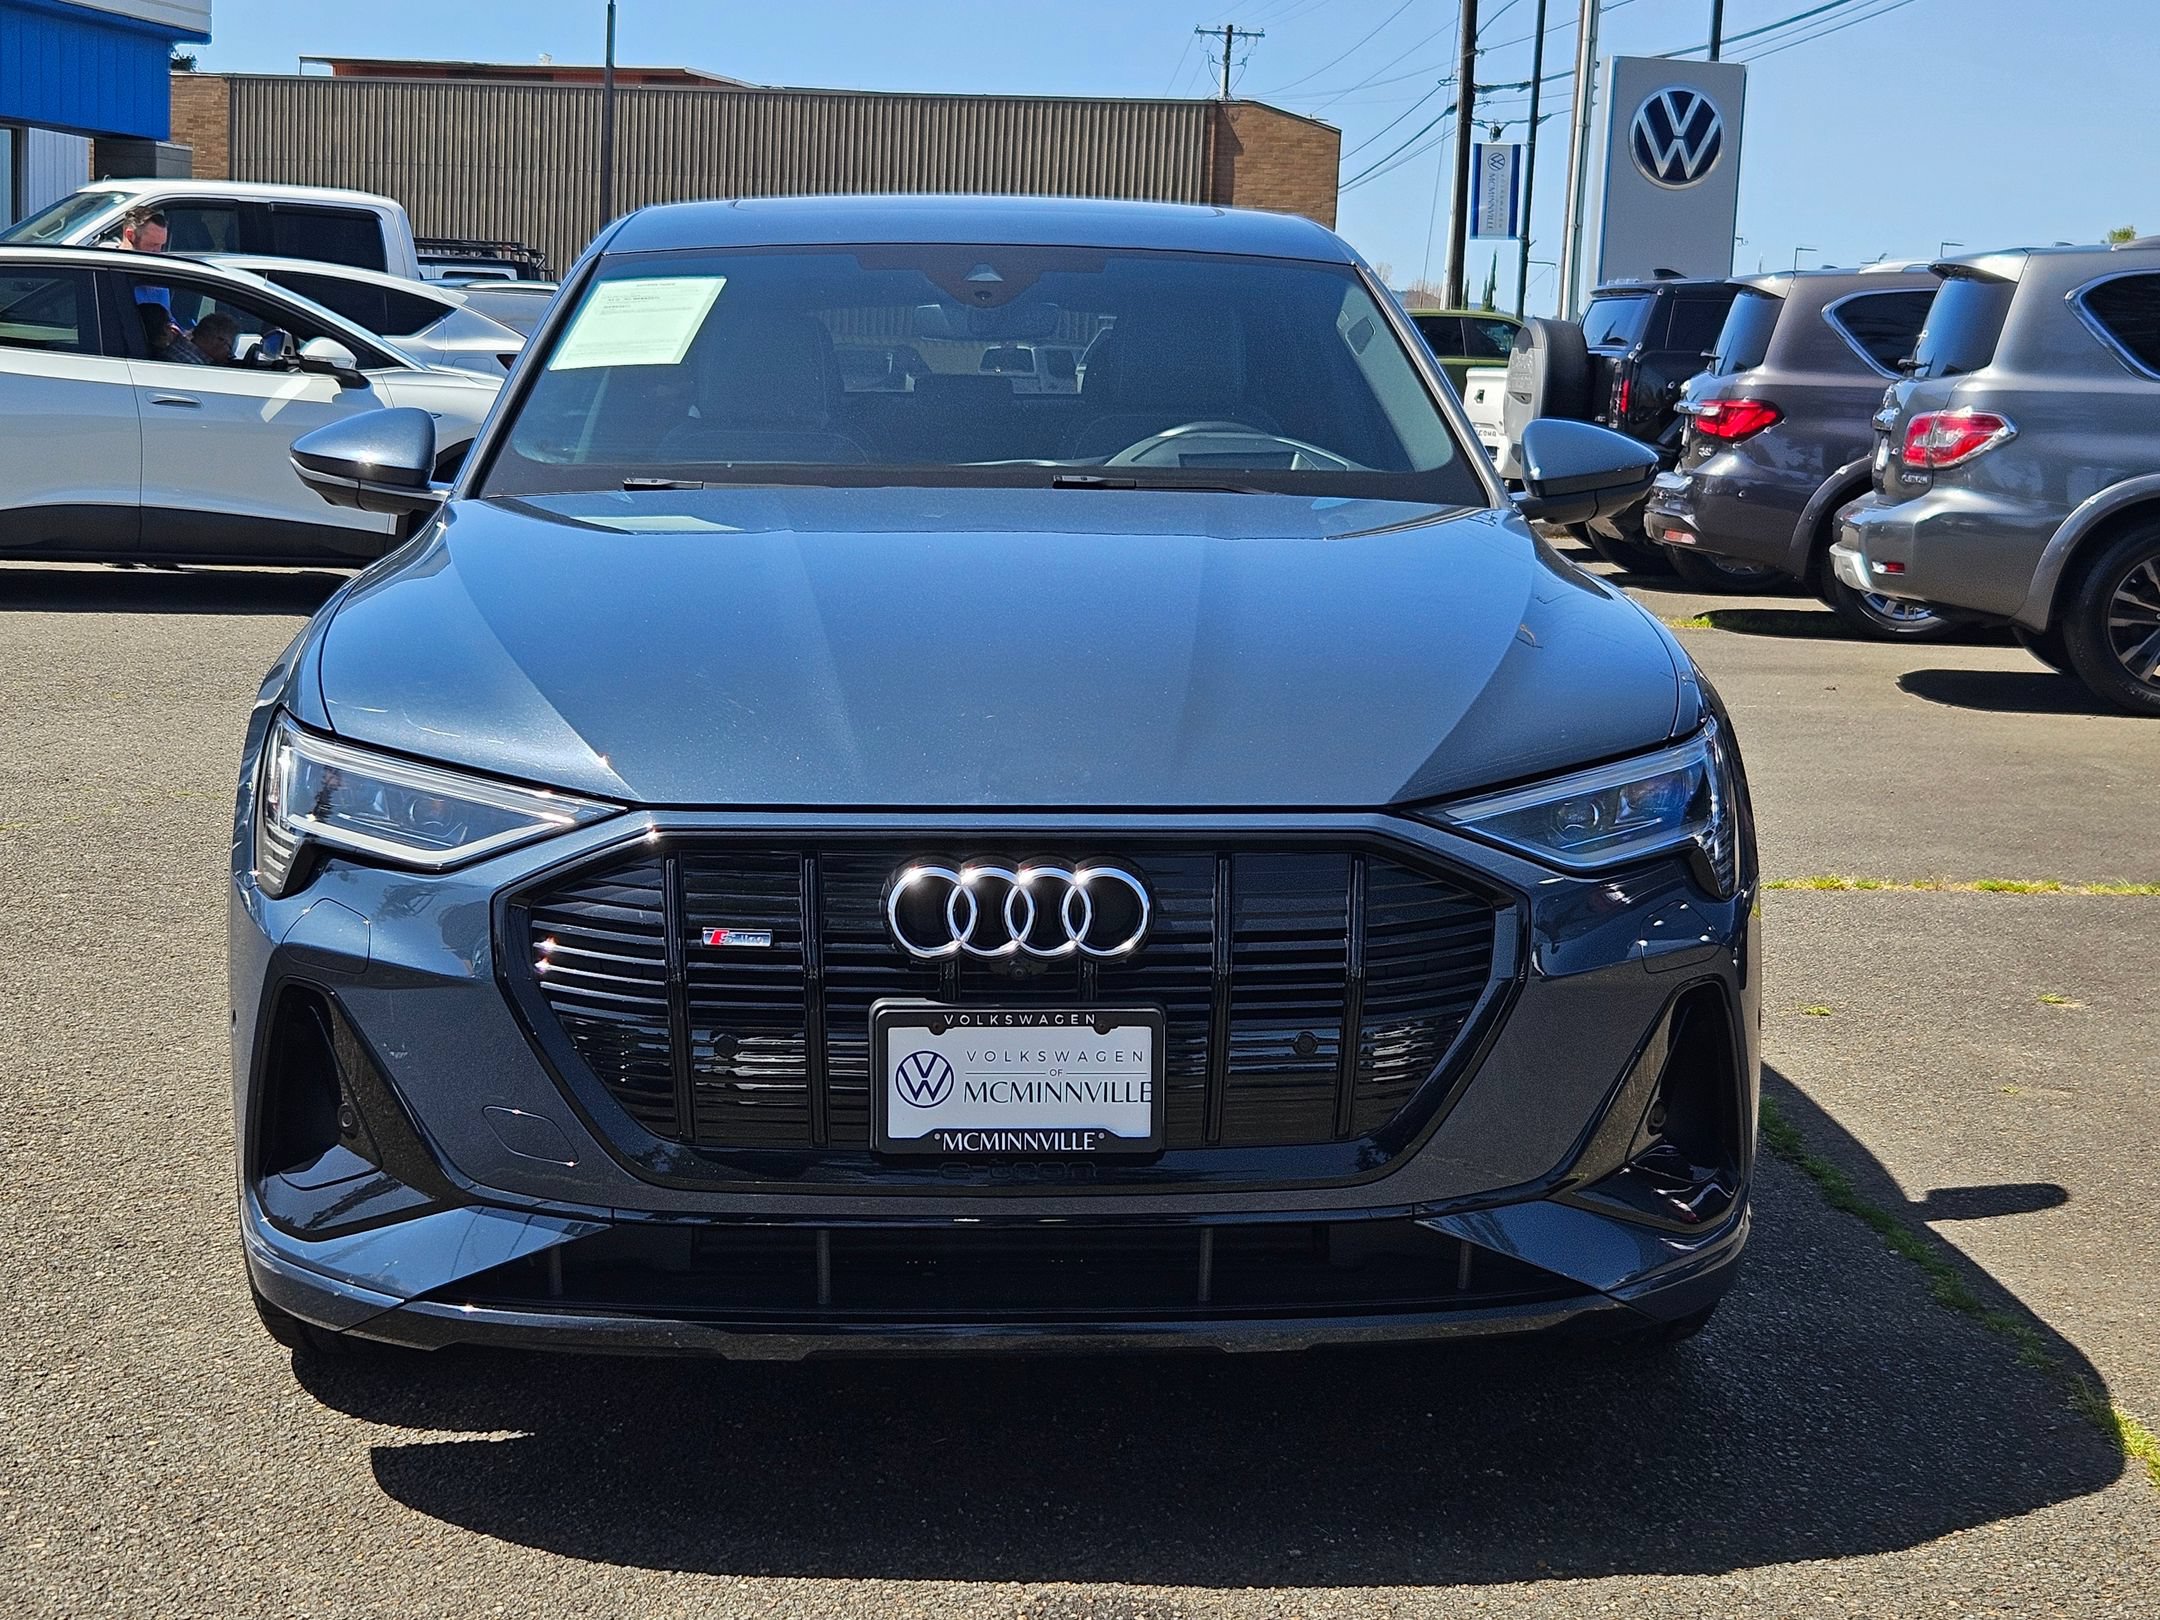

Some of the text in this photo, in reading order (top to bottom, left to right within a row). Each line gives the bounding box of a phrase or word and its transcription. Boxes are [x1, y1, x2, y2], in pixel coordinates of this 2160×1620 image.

[943, 1014, 1096, 1025] VOLKSWAGEN
[967, 1050, 1144, 1063] VOLKSWAGEN
[1049, 1068, 1063, 1077] OF
[963, 1081, 1152, 1103] MCMINNVILLE
[942, 1131, 1096, 1151] MCMINNVILLE
